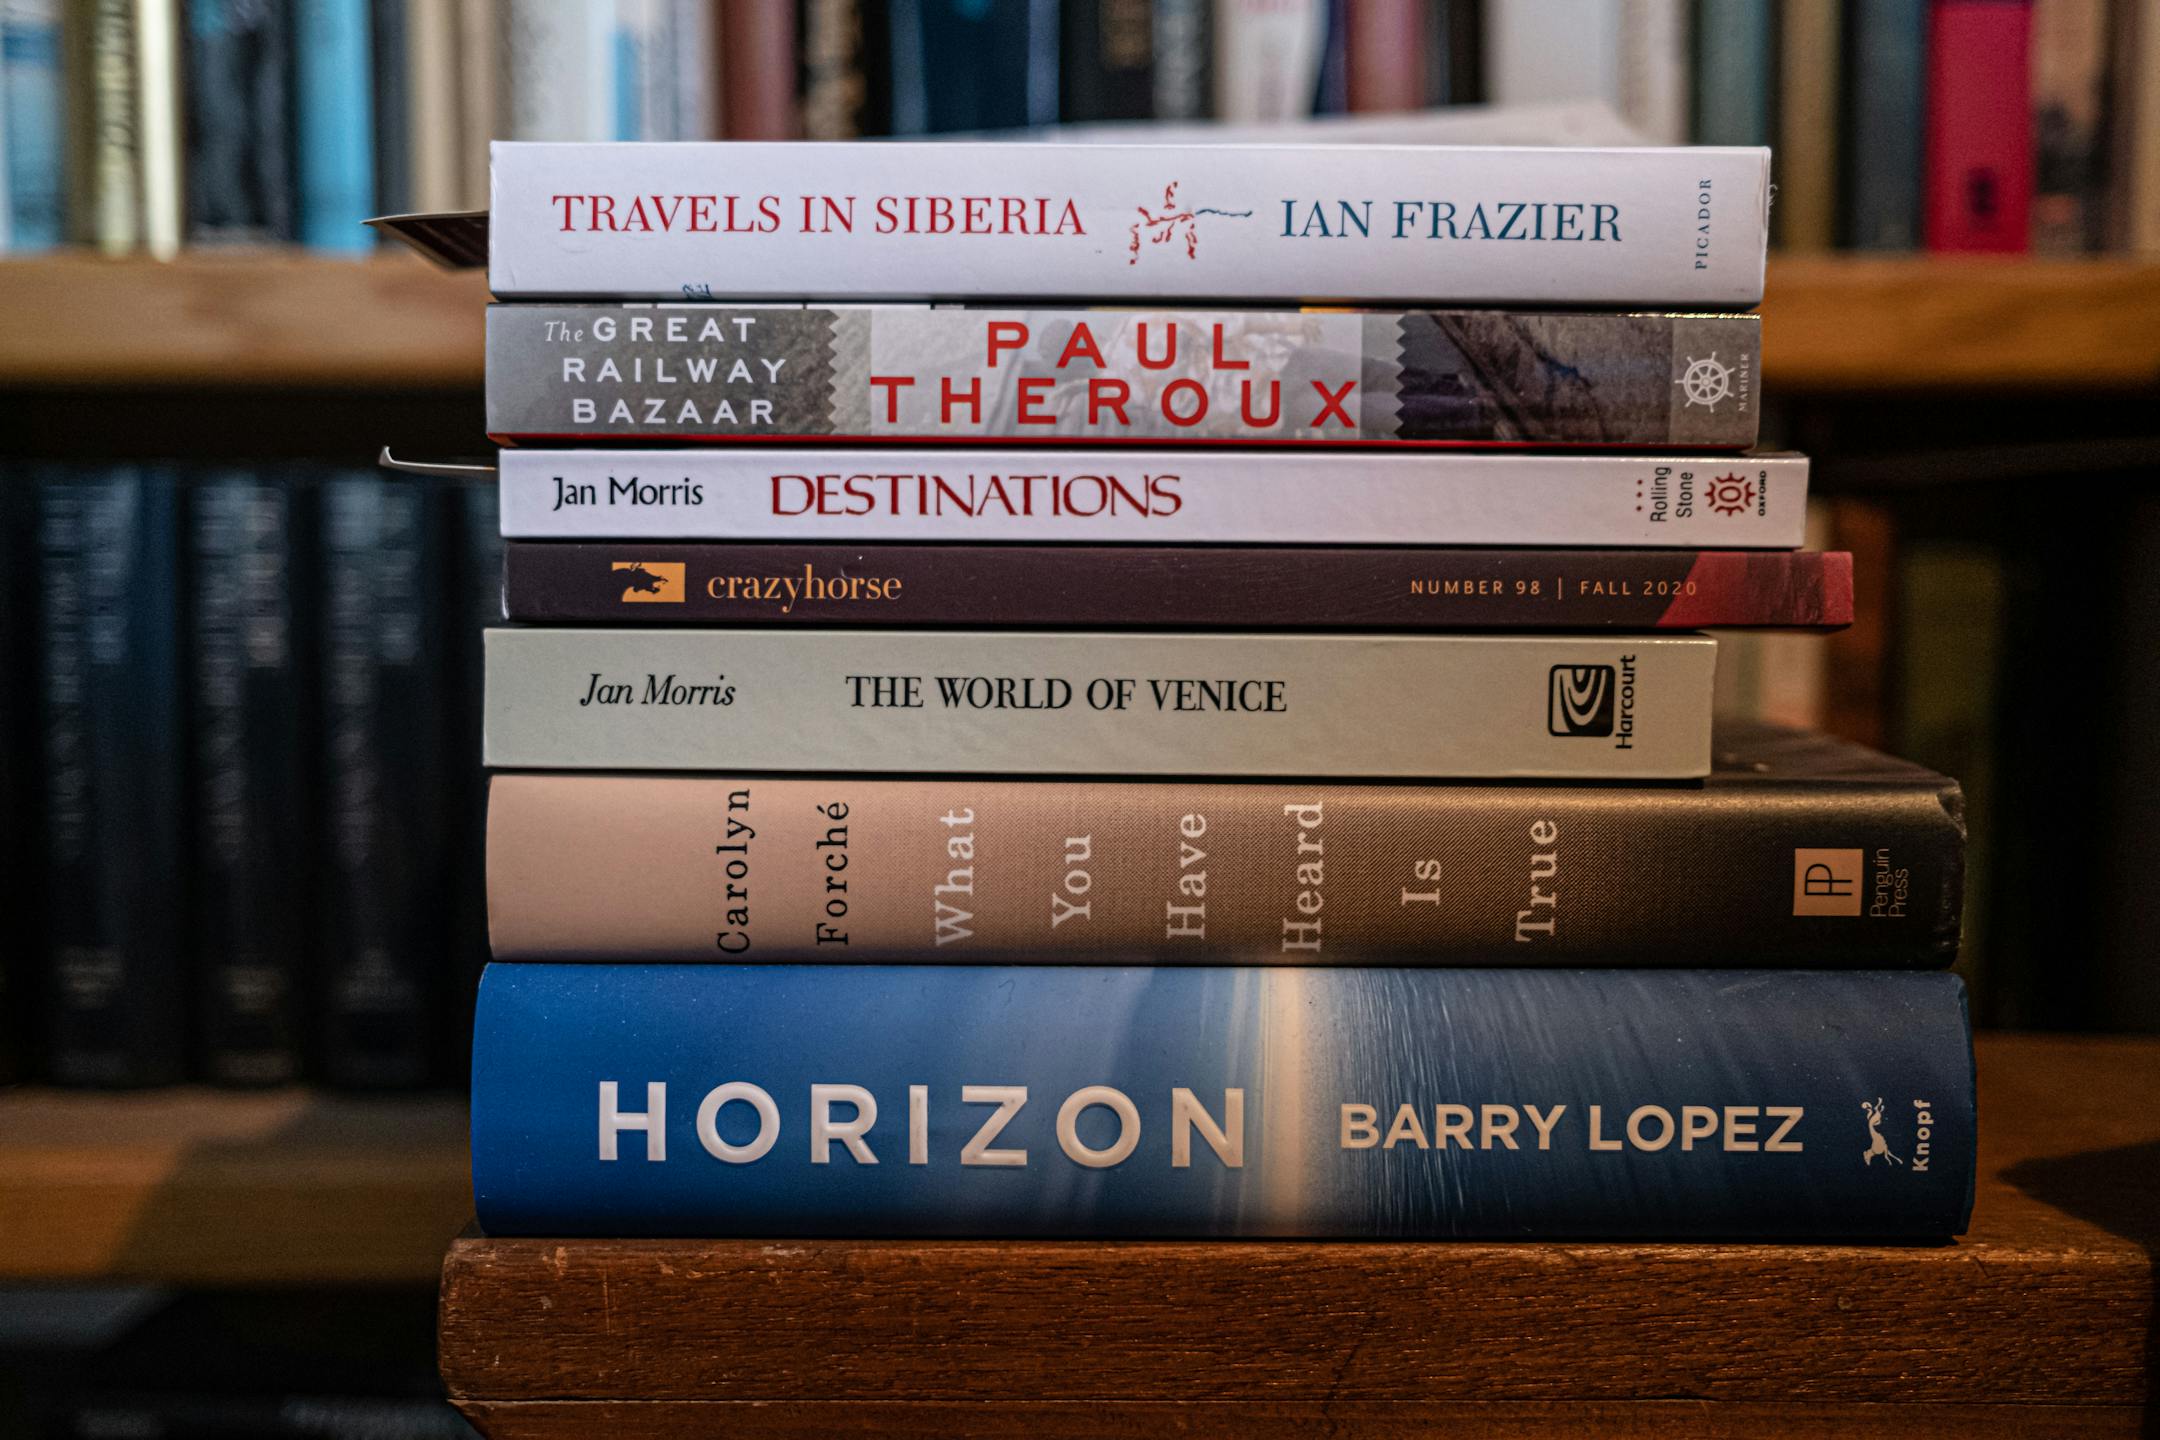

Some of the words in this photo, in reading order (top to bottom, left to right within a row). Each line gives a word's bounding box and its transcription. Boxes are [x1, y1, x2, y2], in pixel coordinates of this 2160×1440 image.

[553, 196, 780, 232] TRAVELS
[799, 196, 856, 233] IN
[875, 197, 1087, 235] SIBERIA
[1280, 200, 1374, 238] IAN
[1392, 201, 1622, 242] FRAZIER
[1695, 179, 1712, 270] PICADOR
[545, 320, 584, 342] The
[593, 317, 755, 341] GREAT
[988, 322, 1249, 369] PAUL
[564, 358, 785, 382] RAILWAY
[1738, 354, 1749, 412] MARINER
[573, 399, 772, 424] BAZAAR
[870, 377, 1356, 428] THEROUX
[553, 477, 596, 511] Jan
[609, 477, 703, 505] Morris
[770, 474, 1183, 518] DESTINATIONS
[1650, 467, 1671, 521] Rolling
[1676, 472, 1693, 517] Stone
[1758, 470, 1767, 516] OXFORD
[708, 564, 901, 612] crazyhorse
[1412, 581, 1502, 594] NUMBER
[1516, 581, 1539, 594] 98
[1581, 581, 1630, 595] FALL
[1643, 580, 1698, 595] 2020
[580, 674, 632, 706] Jan
[642, 674, 735, 705] Morris
[846, 677, 923, 707] THE
[937, 678, 1072, 708] WORLD
[1087, 679, 1135, 710] OF
[1149, 680, 1286, 712] VENICE
[1615, 655, 1636, 749] Harcourt
[716, 789, 755, 953] Carolyn
[816, 802, 849, 945] Forché
[935, 807, 974, 946] What
[1052, 834, 1092, 928] You
[1167, 812, 1207, 940] Have
[1281, 800, 1323, 953] Heard
[1401, 858, 1441, 907] Is
[1515, 819, 1557, 942] True
[1869, 848, 1893, 917] Penguin
[1888, 868, 1909, 917] Press
[600, 1082, 1243, 1166] HORIZON
[1341, 1104, 1565, 1149] BARRY
[1590, 1105, 1803, 1151] LOPEZ
[1913, 1100, 1933, 1170] Knopf
